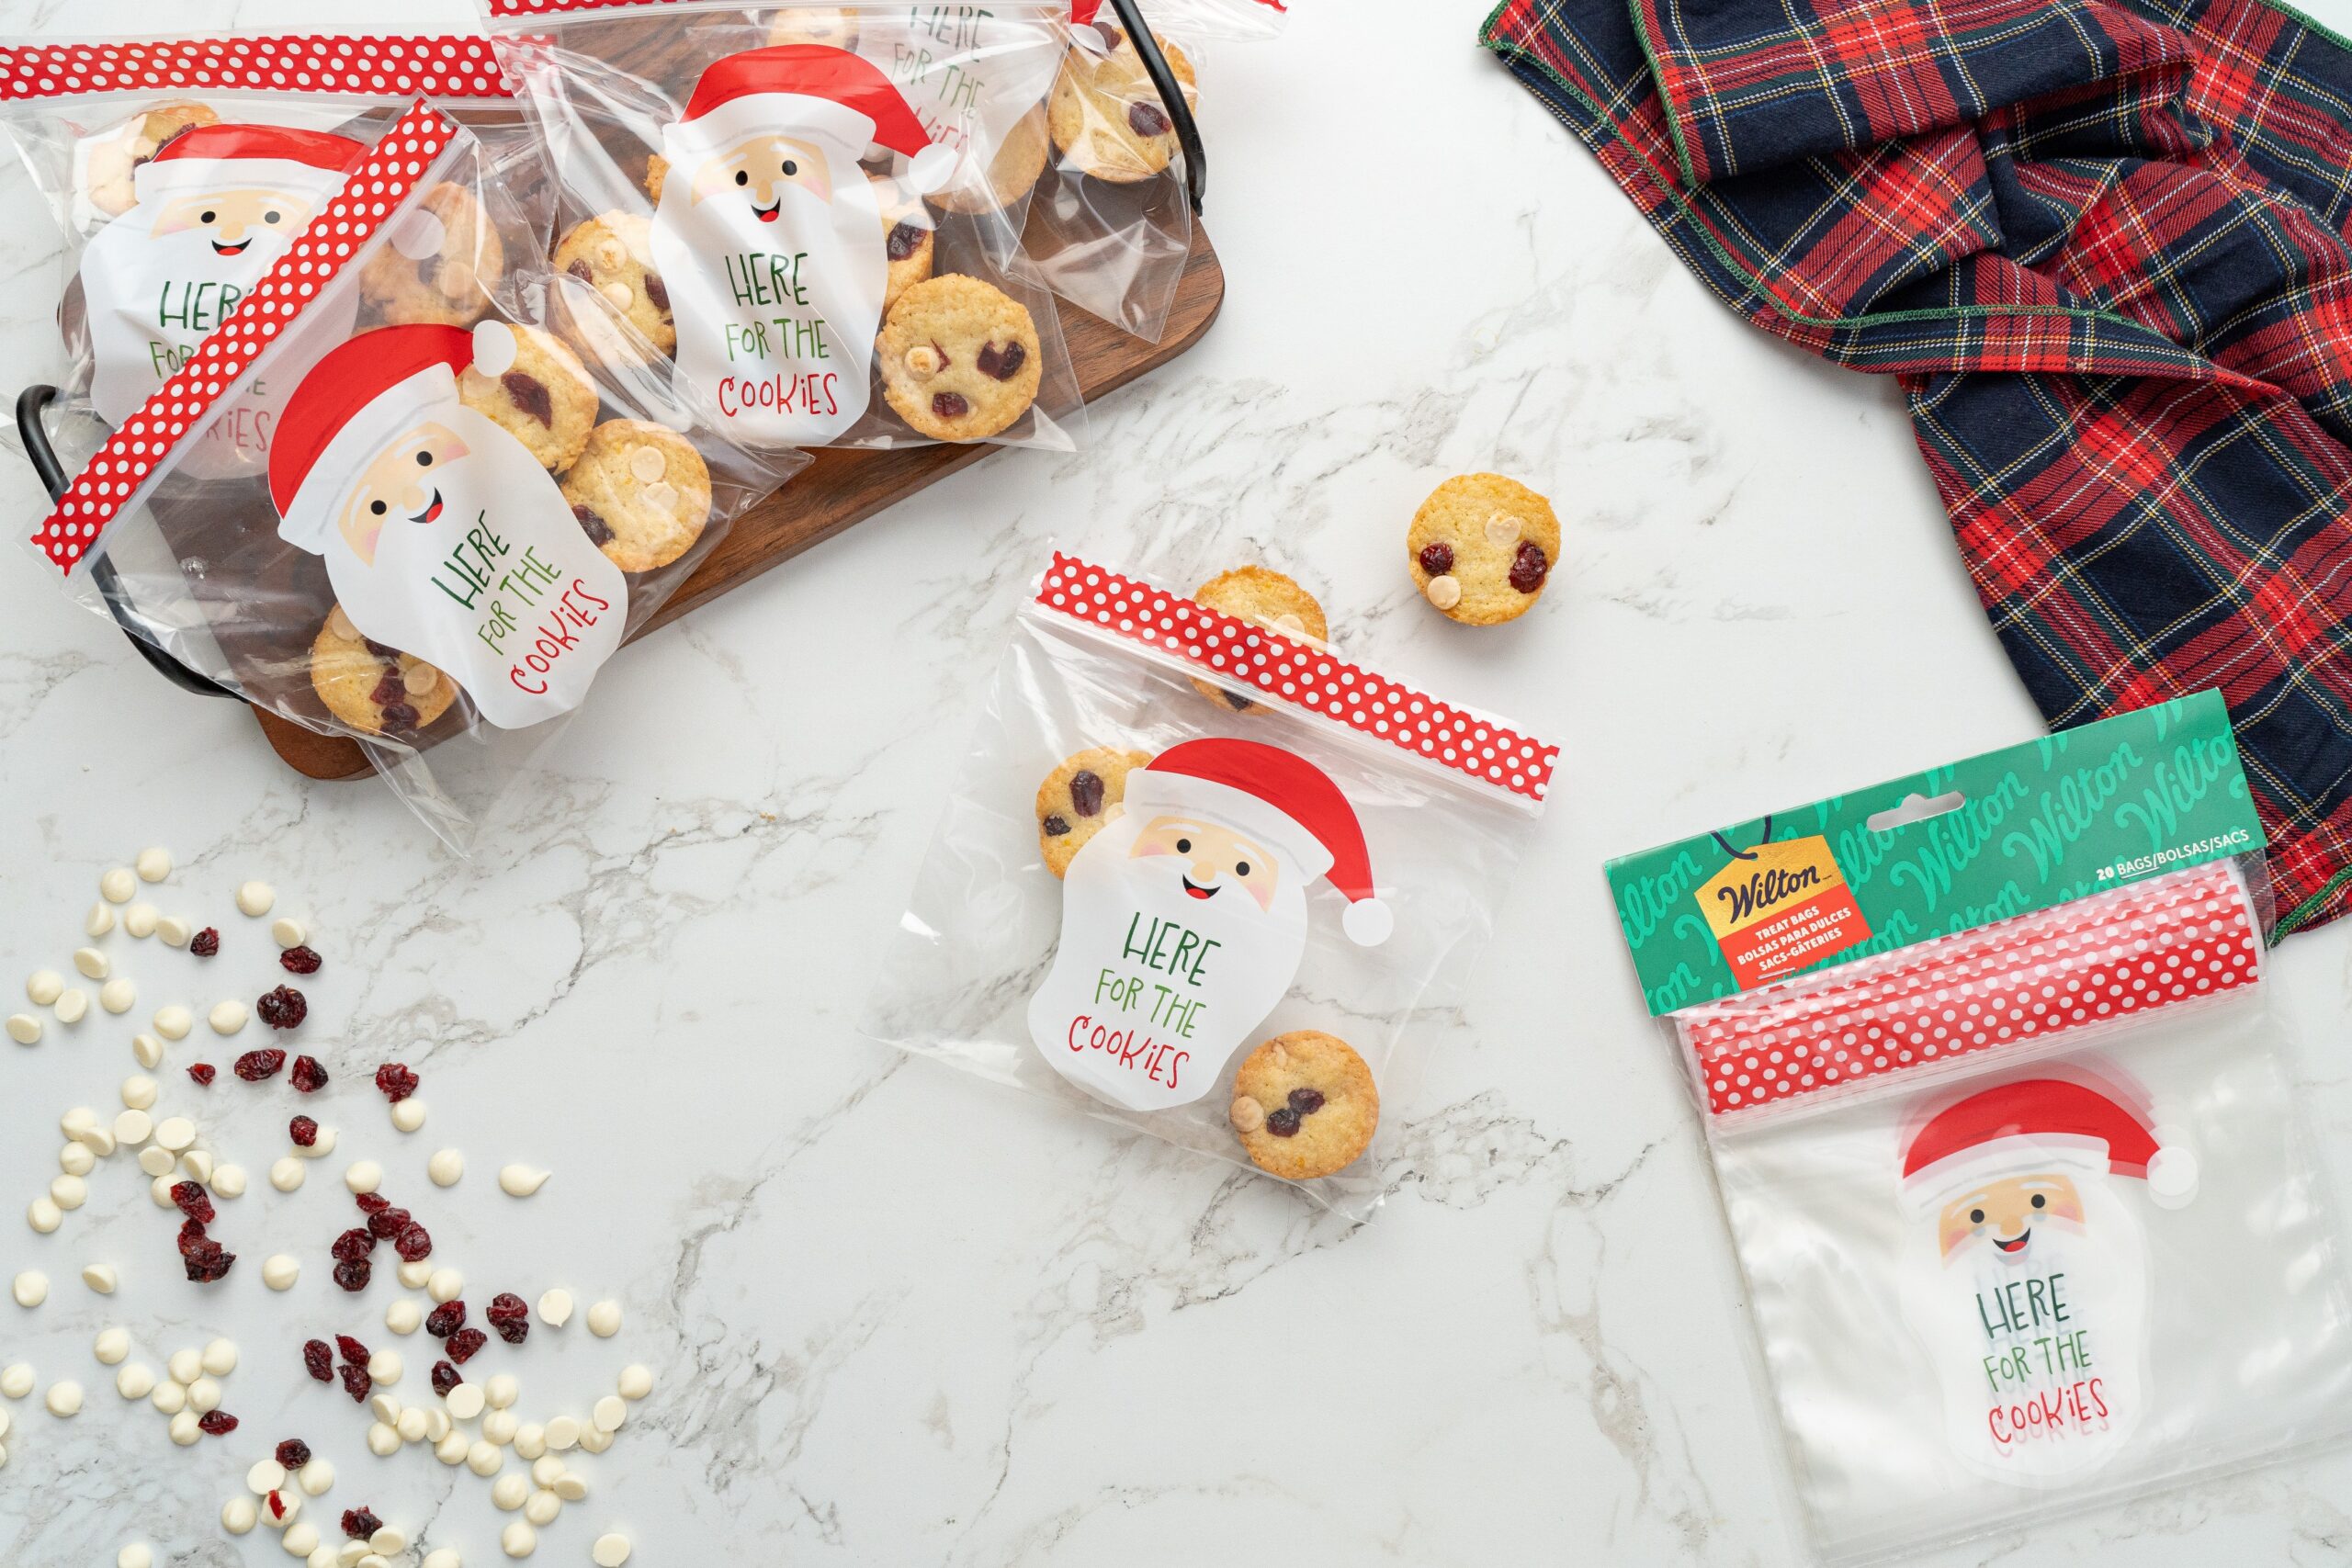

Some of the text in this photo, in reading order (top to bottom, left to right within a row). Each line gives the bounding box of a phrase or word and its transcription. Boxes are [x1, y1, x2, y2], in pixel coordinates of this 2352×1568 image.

[910, 6, 994, 63] HERE
[891, 43, 985, 119] FOR THE
[160, 280, 254, 331] HER
[725, 253, 809, 307] HERE
[725, 318, 830, 362] FOR THE
[430, 509, 510, 610] HERE
[478, 546, 561, 655] FOR THE
[2001, 740, 2144, 884] Wilton
[2114, 723, 2234, 859] Wilto
[1889, 771, 2030, 913] Wilton
[2096, 865, 2115, 881] 20
[2116, 829, 2250, 875] BAGS/BOLSAS/SACS
[1619, 851, 1703, 950] ilton
[1717, 865, 1821, 924] Wilton
[1755, 906, 1820, 941] TREAT BAGS
[1122, 911, 1222, 987] HERE
[1736, 940, 1780, 965] BOLSAS
[1780, 927, 1810, 946] PARA
[1809, 907, 1852, 932] DULCES
[1758, 927, 1843, 971] SACS-GÂTERIES
[1094, 968, 1207, 1039] FOR THE
[1976, 1273, 2071, 1339] HERE
[1983, 1330, 2093, 1393] FOR THE
